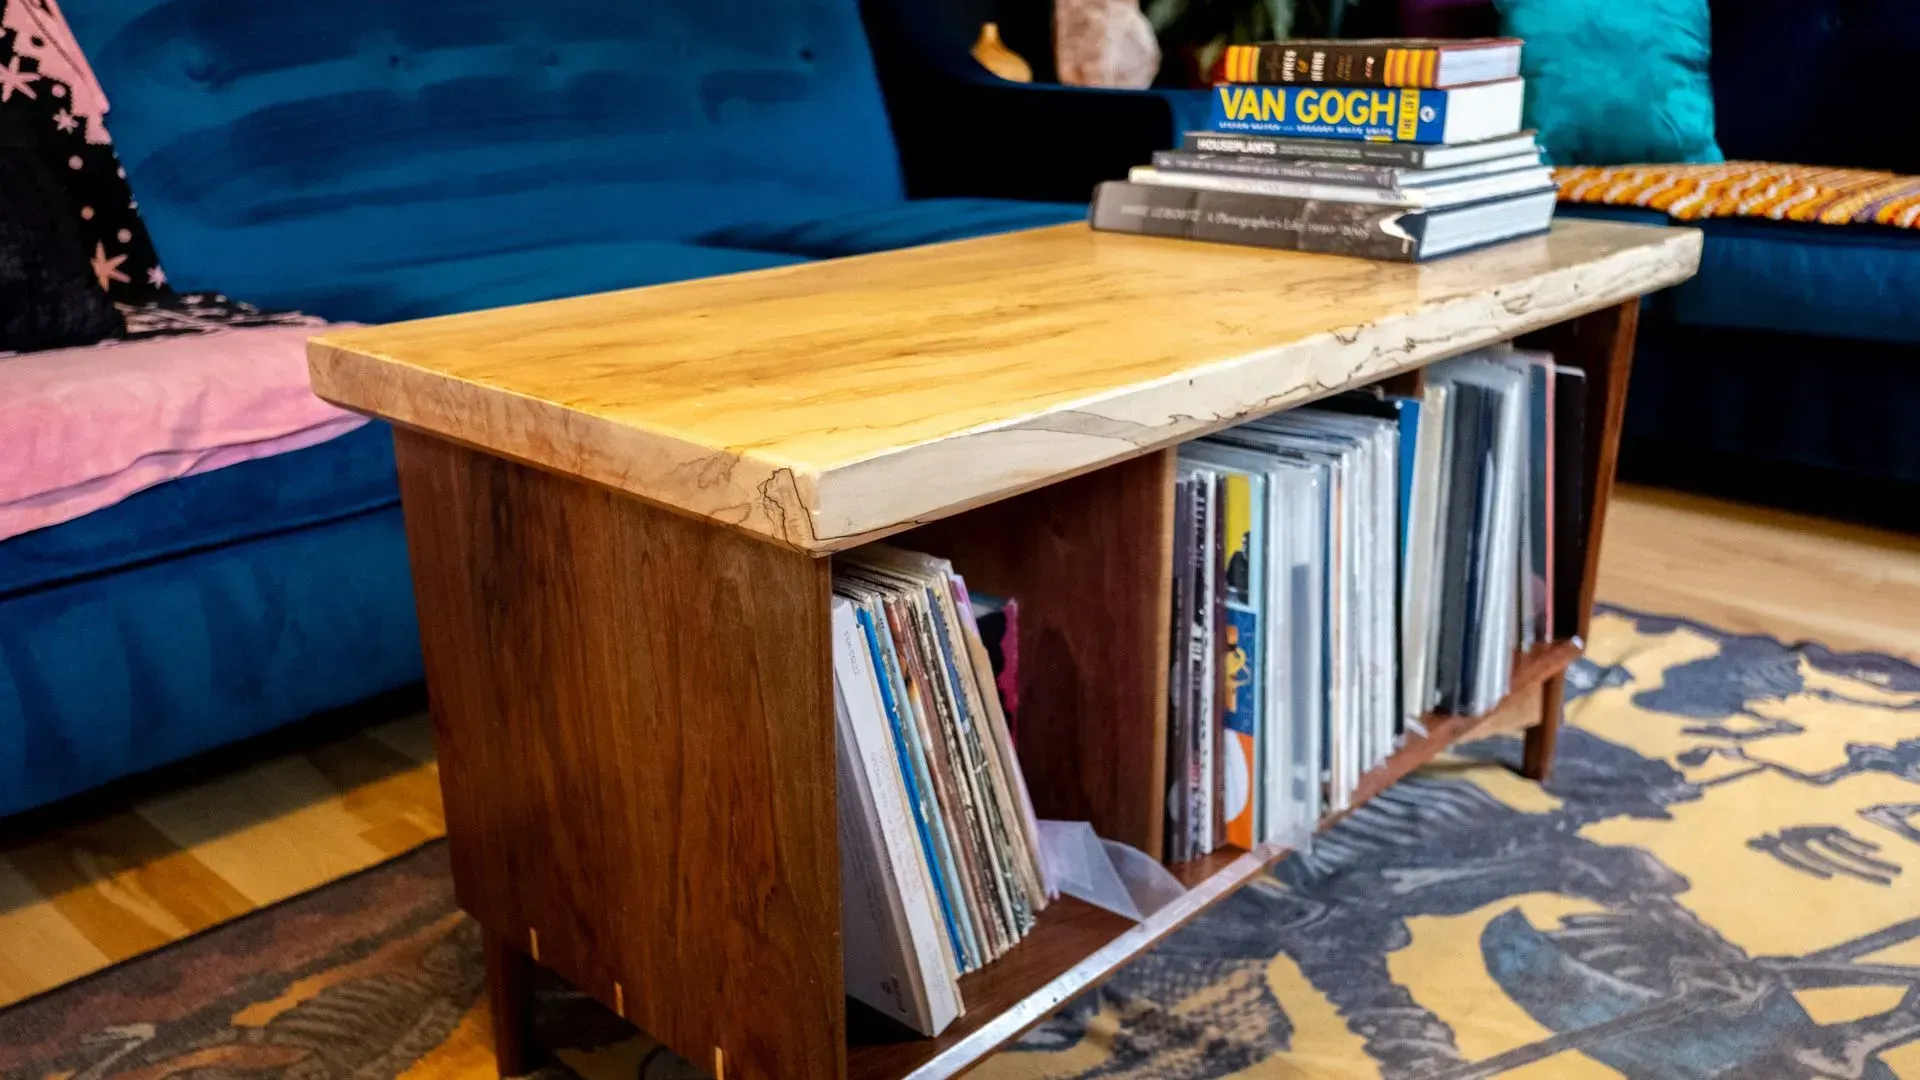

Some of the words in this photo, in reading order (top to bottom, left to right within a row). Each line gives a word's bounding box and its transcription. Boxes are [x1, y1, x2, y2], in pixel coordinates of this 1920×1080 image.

[1219, 87, 1287, 122] VAN
[1294, 88, 1396, 126] GOGH
[1197, 138, 1277, 155] HOUSEPLANTS
